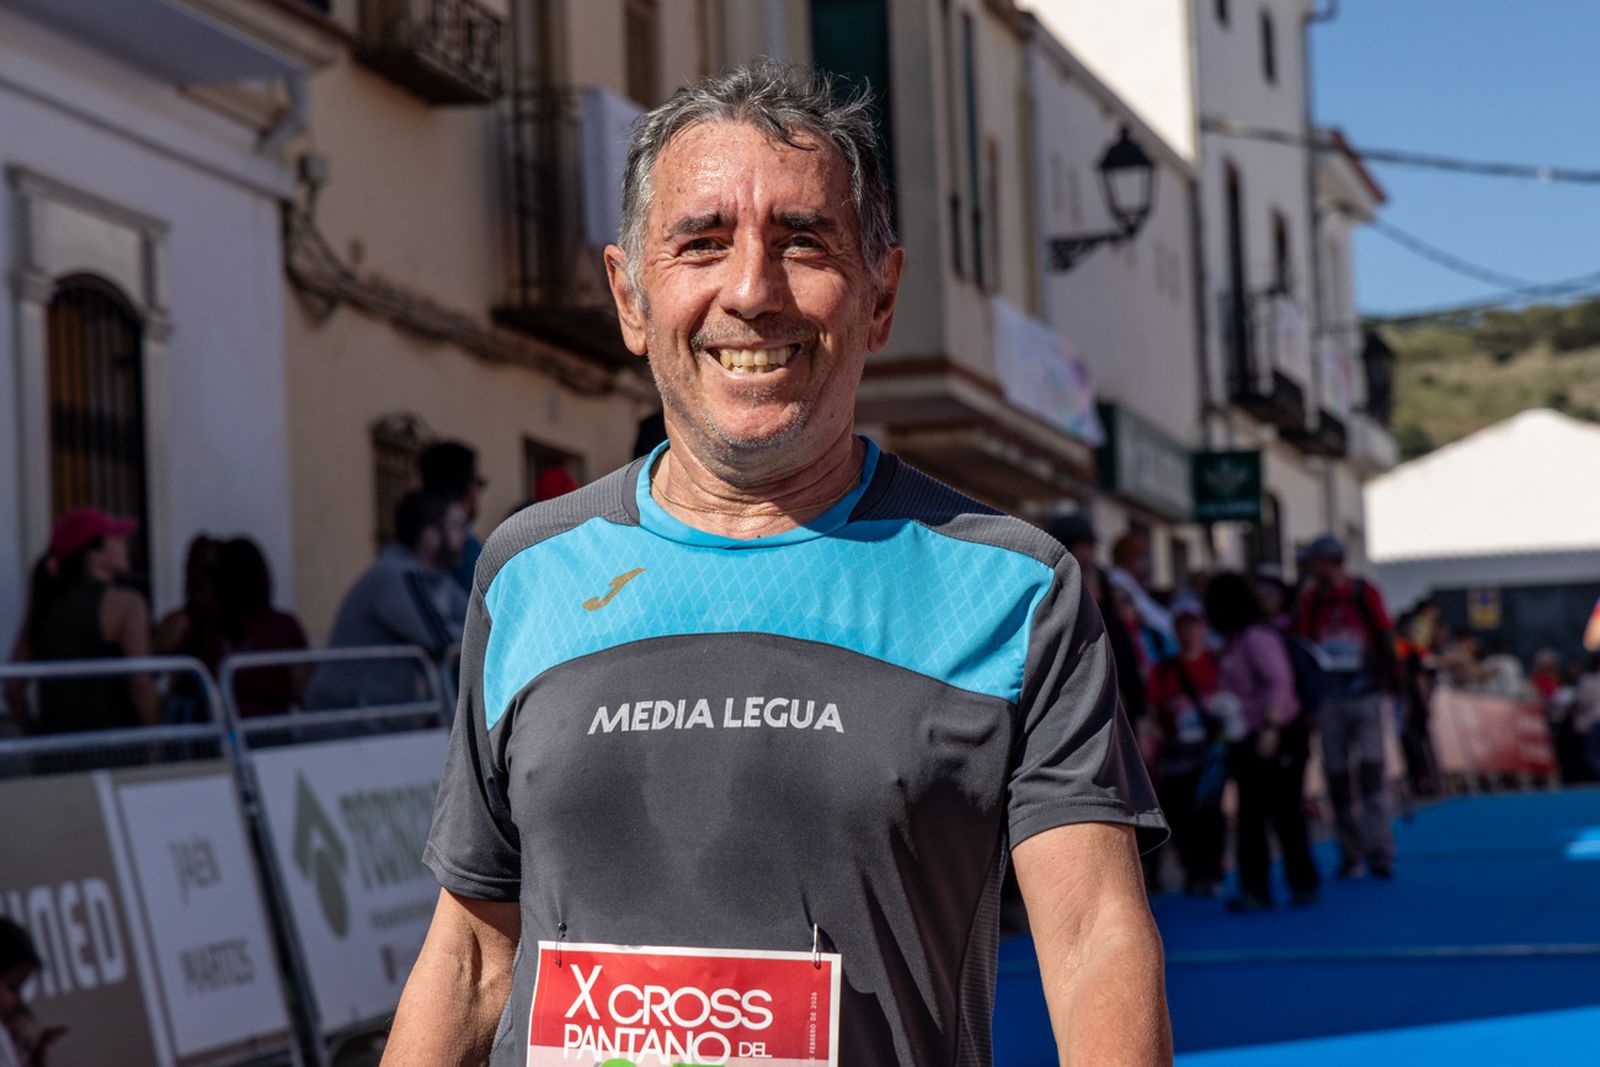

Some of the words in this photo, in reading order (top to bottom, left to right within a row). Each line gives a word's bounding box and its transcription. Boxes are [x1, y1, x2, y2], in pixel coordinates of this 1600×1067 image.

[587, 698, 714, 735] MEDIA
[723, 697, 844, 733] LEGUA
[0, 878, 127, 1003] NED
[564, 964, 602, 1020] X
[608, 984, 774, 1030] CROSS
[810, 991, 818, 1009] 2026
[810, 1012, 817, 1021] DE
[563, 1024, 731, 1066] PANTANO
[738, 1042, 773, 1058] DEL
